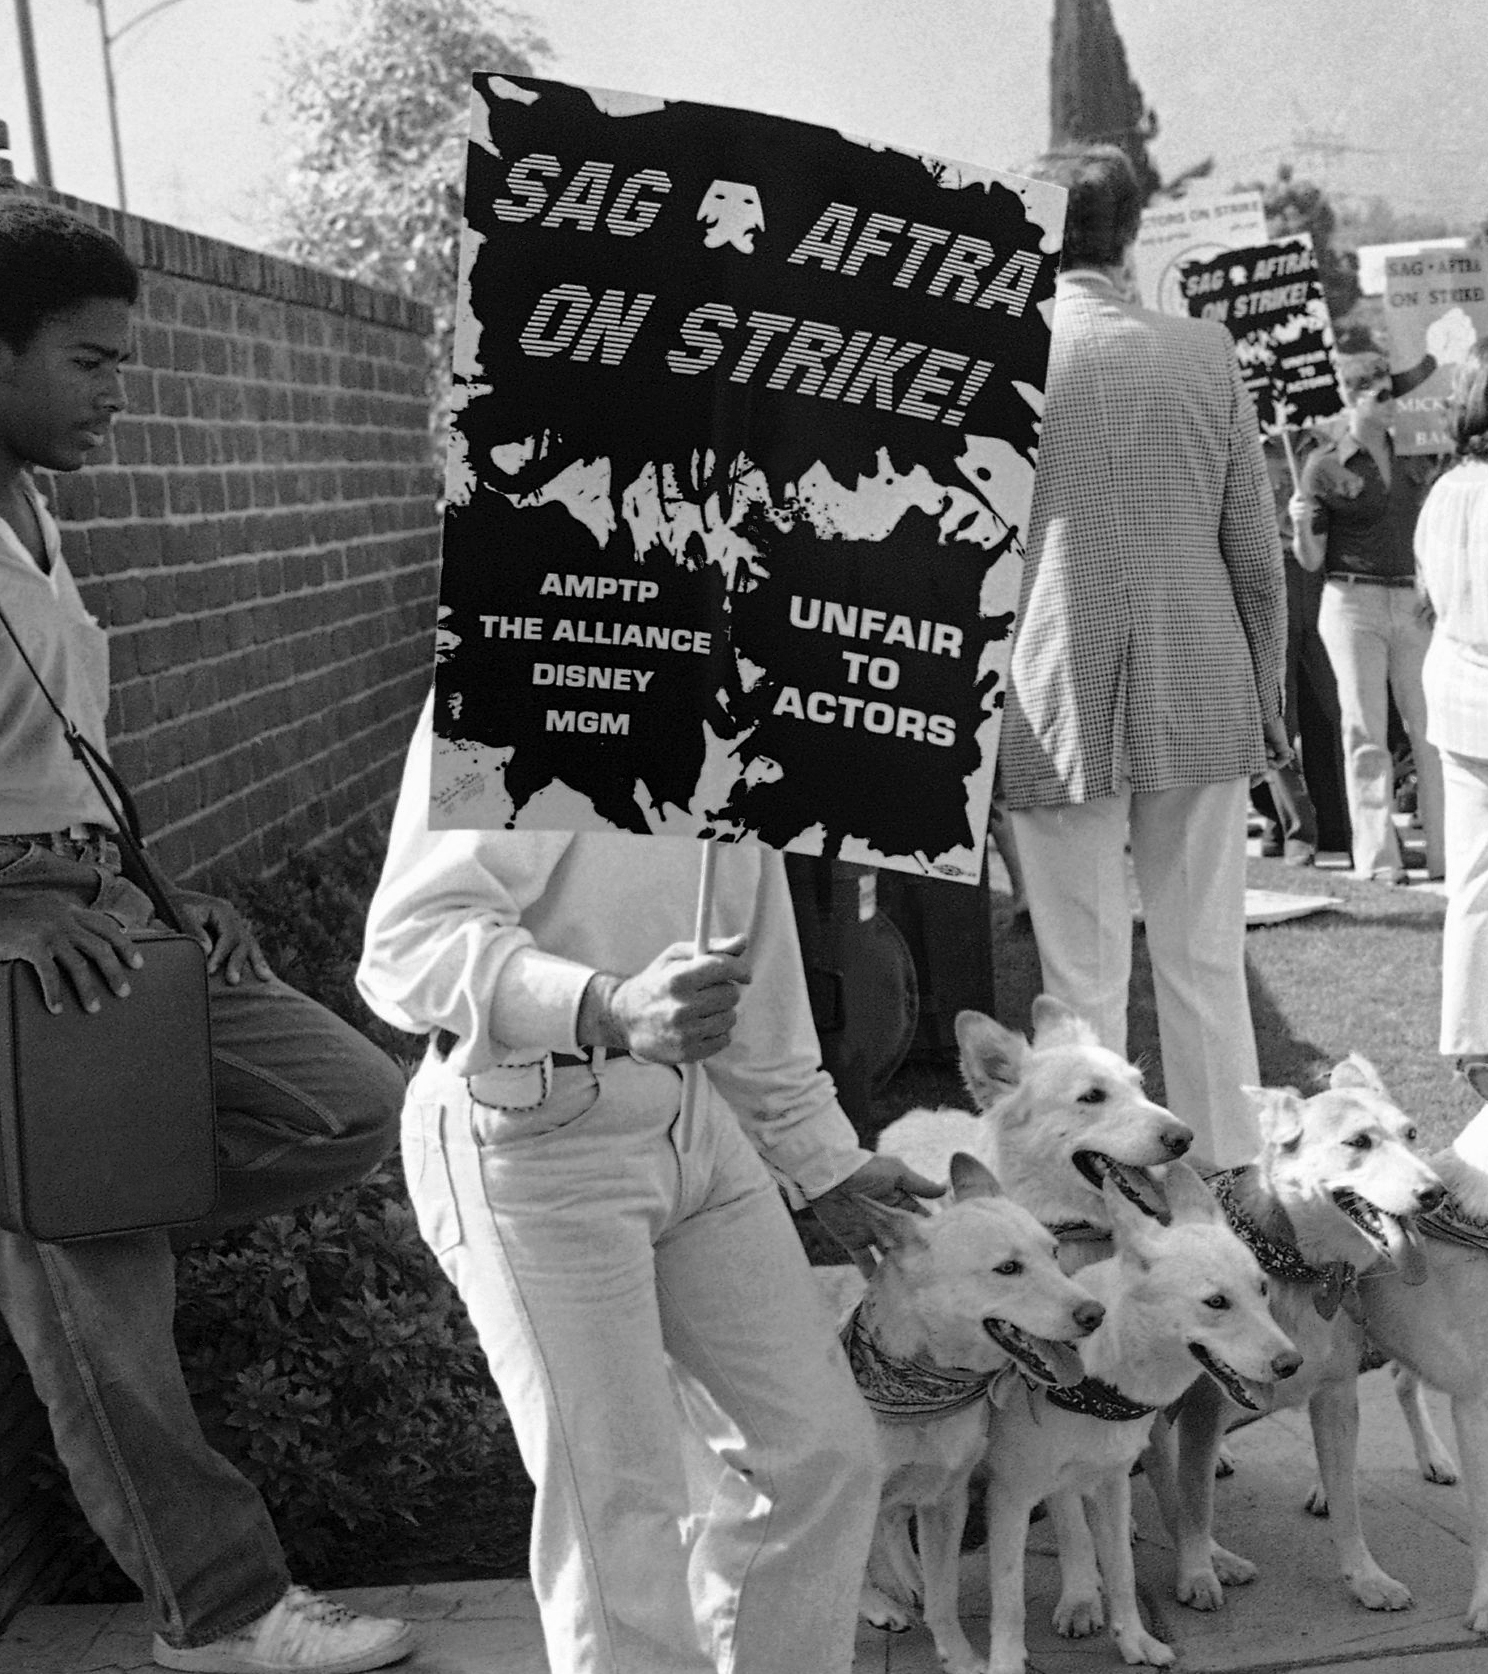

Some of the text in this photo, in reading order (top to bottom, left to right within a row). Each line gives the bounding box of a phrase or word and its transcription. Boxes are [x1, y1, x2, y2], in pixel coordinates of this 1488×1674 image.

[492, 154, 1043, 318] SAG AFTRA
[1186, 252, 1311, 297] SAG AFTRA
[1388, 261, 1424, 276] SAG
[1201, 282, 1308, 322] ON STRIKE!
[1390, 292, 1419, 307] ON
[519, 284, 995, 427] ON STRIKE!
[539, 572, 659, 602] AMPTP
[480, 616, 712, 655] THE ALLIANCE
[789, 595, 963, 659] UNFAIR
[533, 663, 655, 693] DISNEY
[841, 651, 900, 690] TO
[545, 710, 630, 735] MGM
[773, 686, 957, 747] ACTORS
